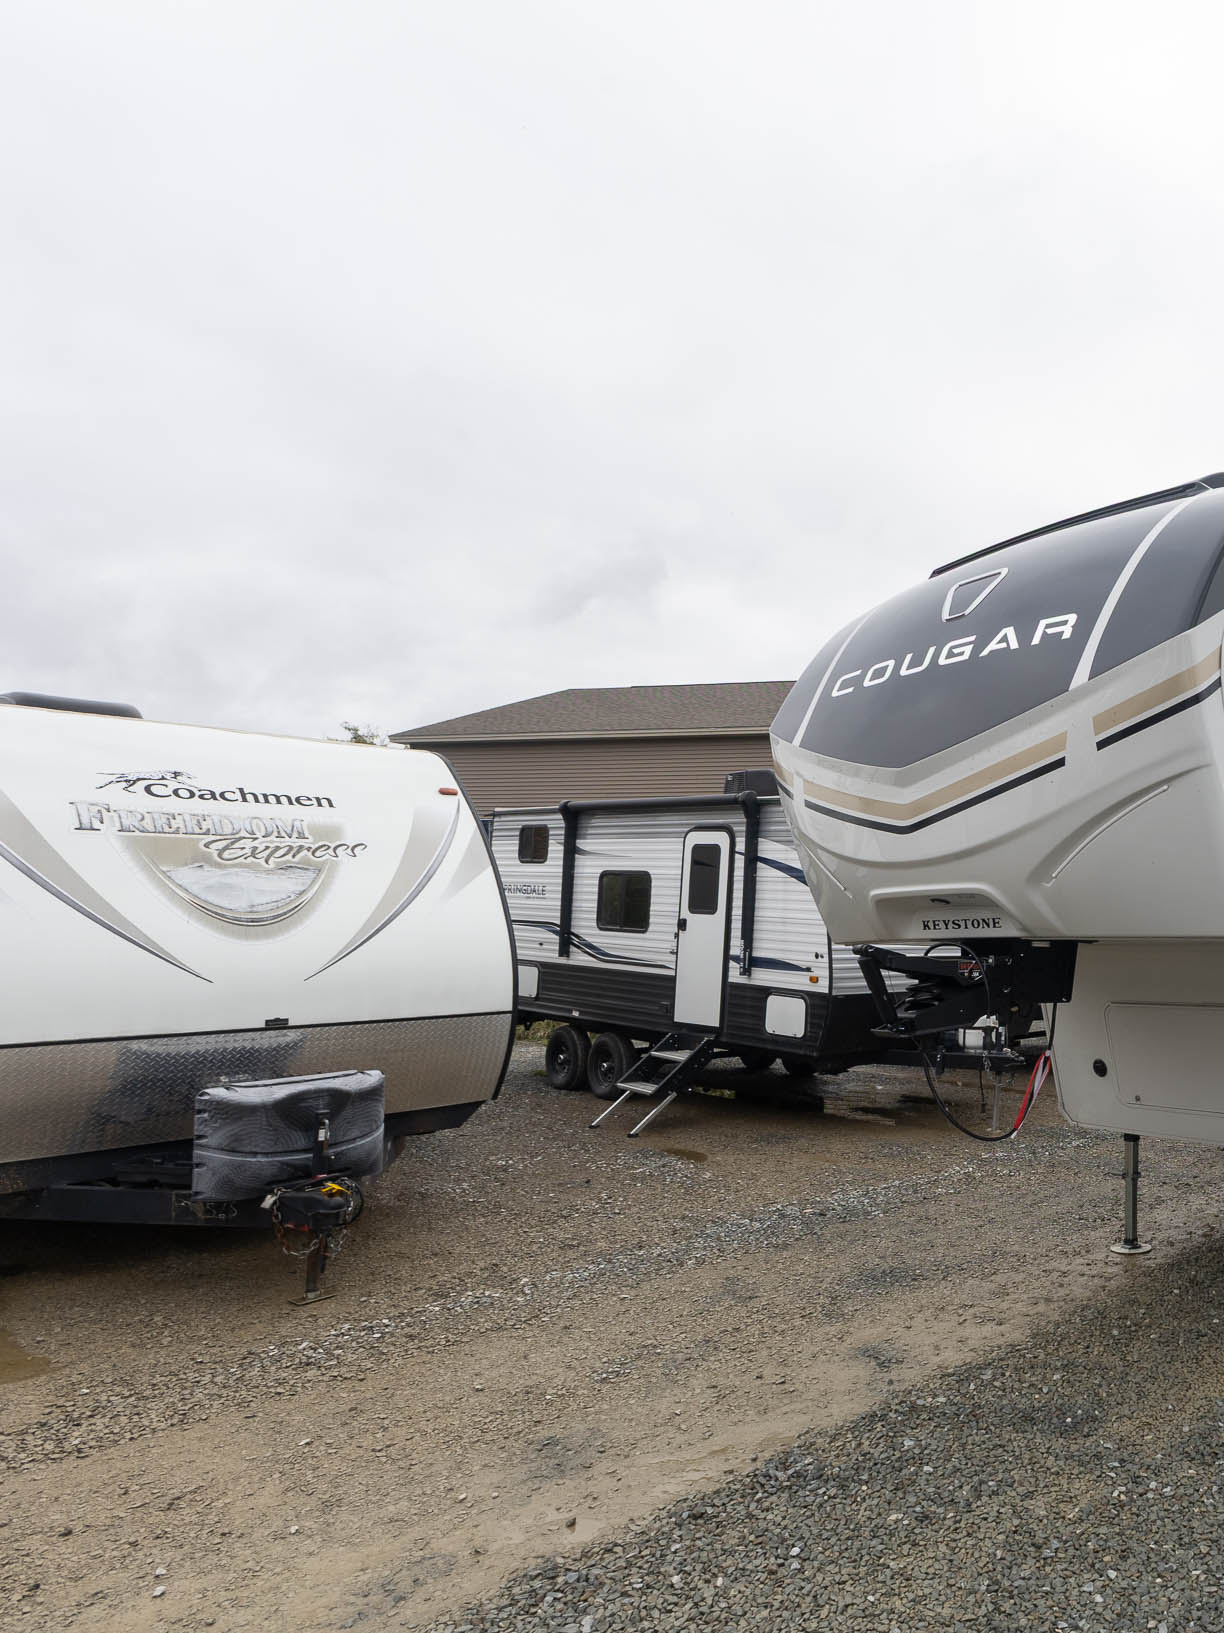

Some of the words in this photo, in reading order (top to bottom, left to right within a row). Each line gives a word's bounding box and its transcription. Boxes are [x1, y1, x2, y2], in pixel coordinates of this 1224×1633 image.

[832, 613, 1078, 697] COUGAR
[144, 783, 336, 808] Coachmen
[69, 801, 309, 840] FREEDOM
[203, 836, 367, 865] Express
[503, 883, 547, 896] PRINGDALE
[921, 917, 1002, 930] KEYSTONE
